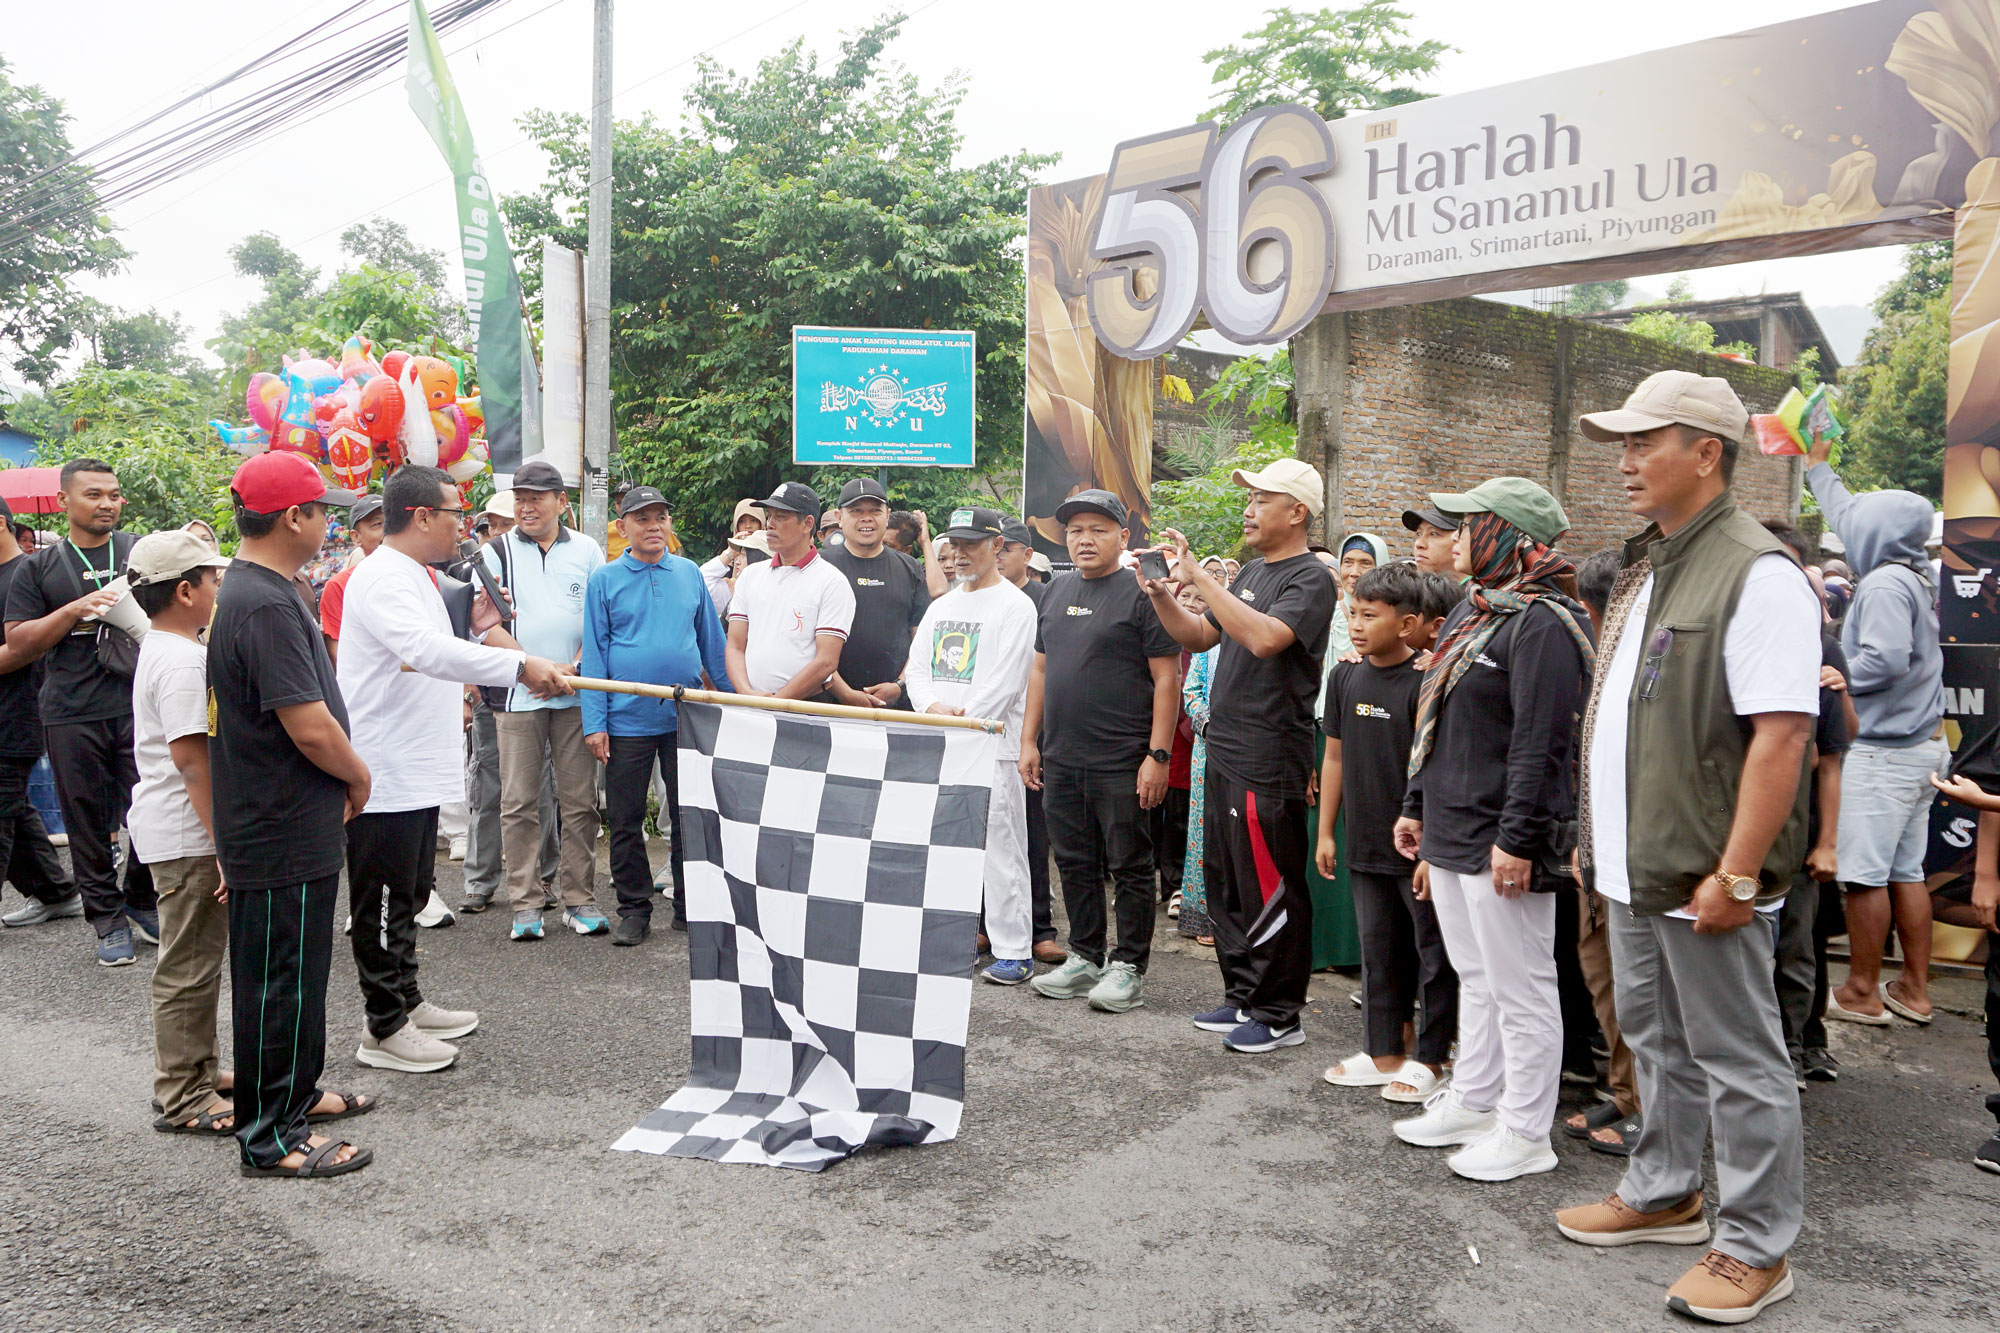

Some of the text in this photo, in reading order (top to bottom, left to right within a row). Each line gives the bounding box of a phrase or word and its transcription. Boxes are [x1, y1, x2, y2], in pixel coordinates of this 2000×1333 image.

[1371, 122, 1392, 139] TH
[1364, 113, 1581, 201] Harlah
[1367, 156, 1718, 245] MI Sananul Ula
[463, 206, 489, 261] Ula
[1086, 103, 1338, 361] 56
[1367, 208, 1717, 271] Daraman, Srimartani, Piyungan
[798, 335, 971, 348] PENGURUS ANAK RANTING NAHDLATUL ULAMA
[842, 346, 927, 356] PADUKUHAN DARAMAN
[845, 416, 858, 430] N
[1356, 703, 1370, 716] 56
